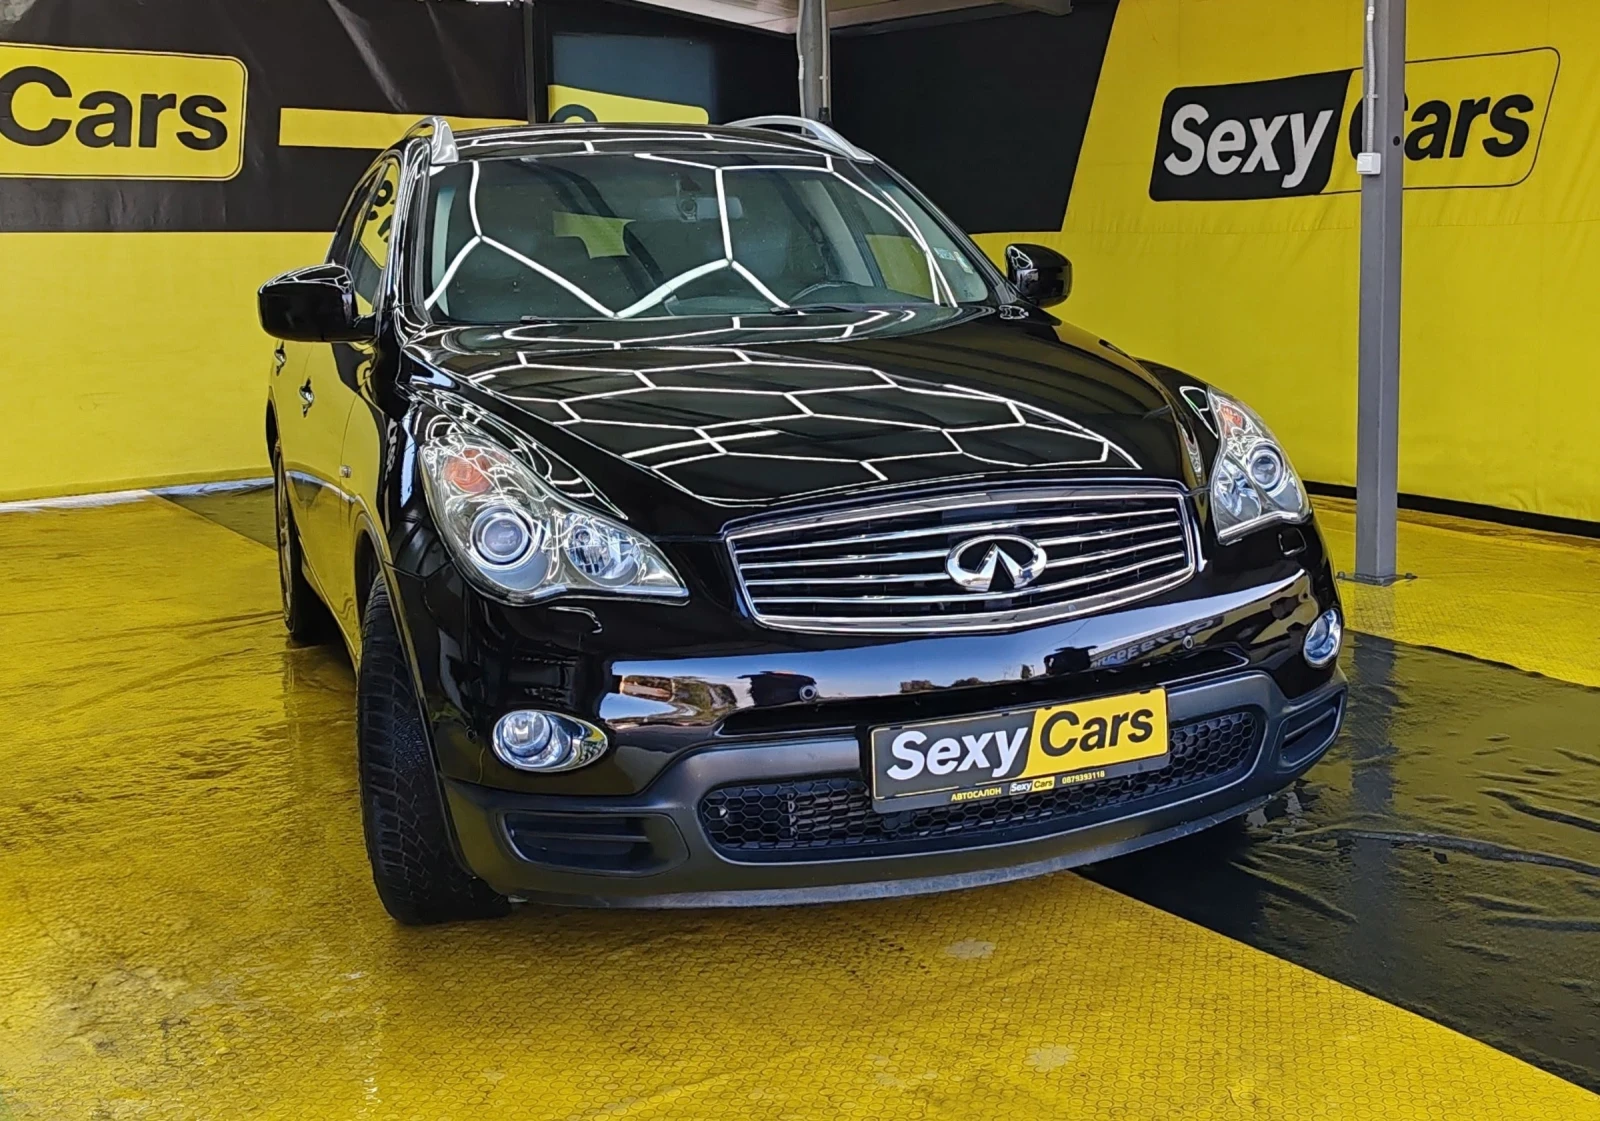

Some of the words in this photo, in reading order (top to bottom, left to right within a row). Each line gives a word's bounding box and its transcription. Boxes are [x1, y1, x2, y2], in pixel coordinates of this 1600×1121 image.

[0, 66, 227, 151] Cars
[1164, 103, 1334, 188] Sexy
[887, 726, 1028, 780] Sexy
[1040, 708, 1153, 757] Cars
[951, 787, 1002, 802] АВТОСАЛОН
[1010, 781, 1032, 793] Sexy
[1033, 778, 1053, 789] Cars
[1062, 770, 1105, 785] 0879393118
